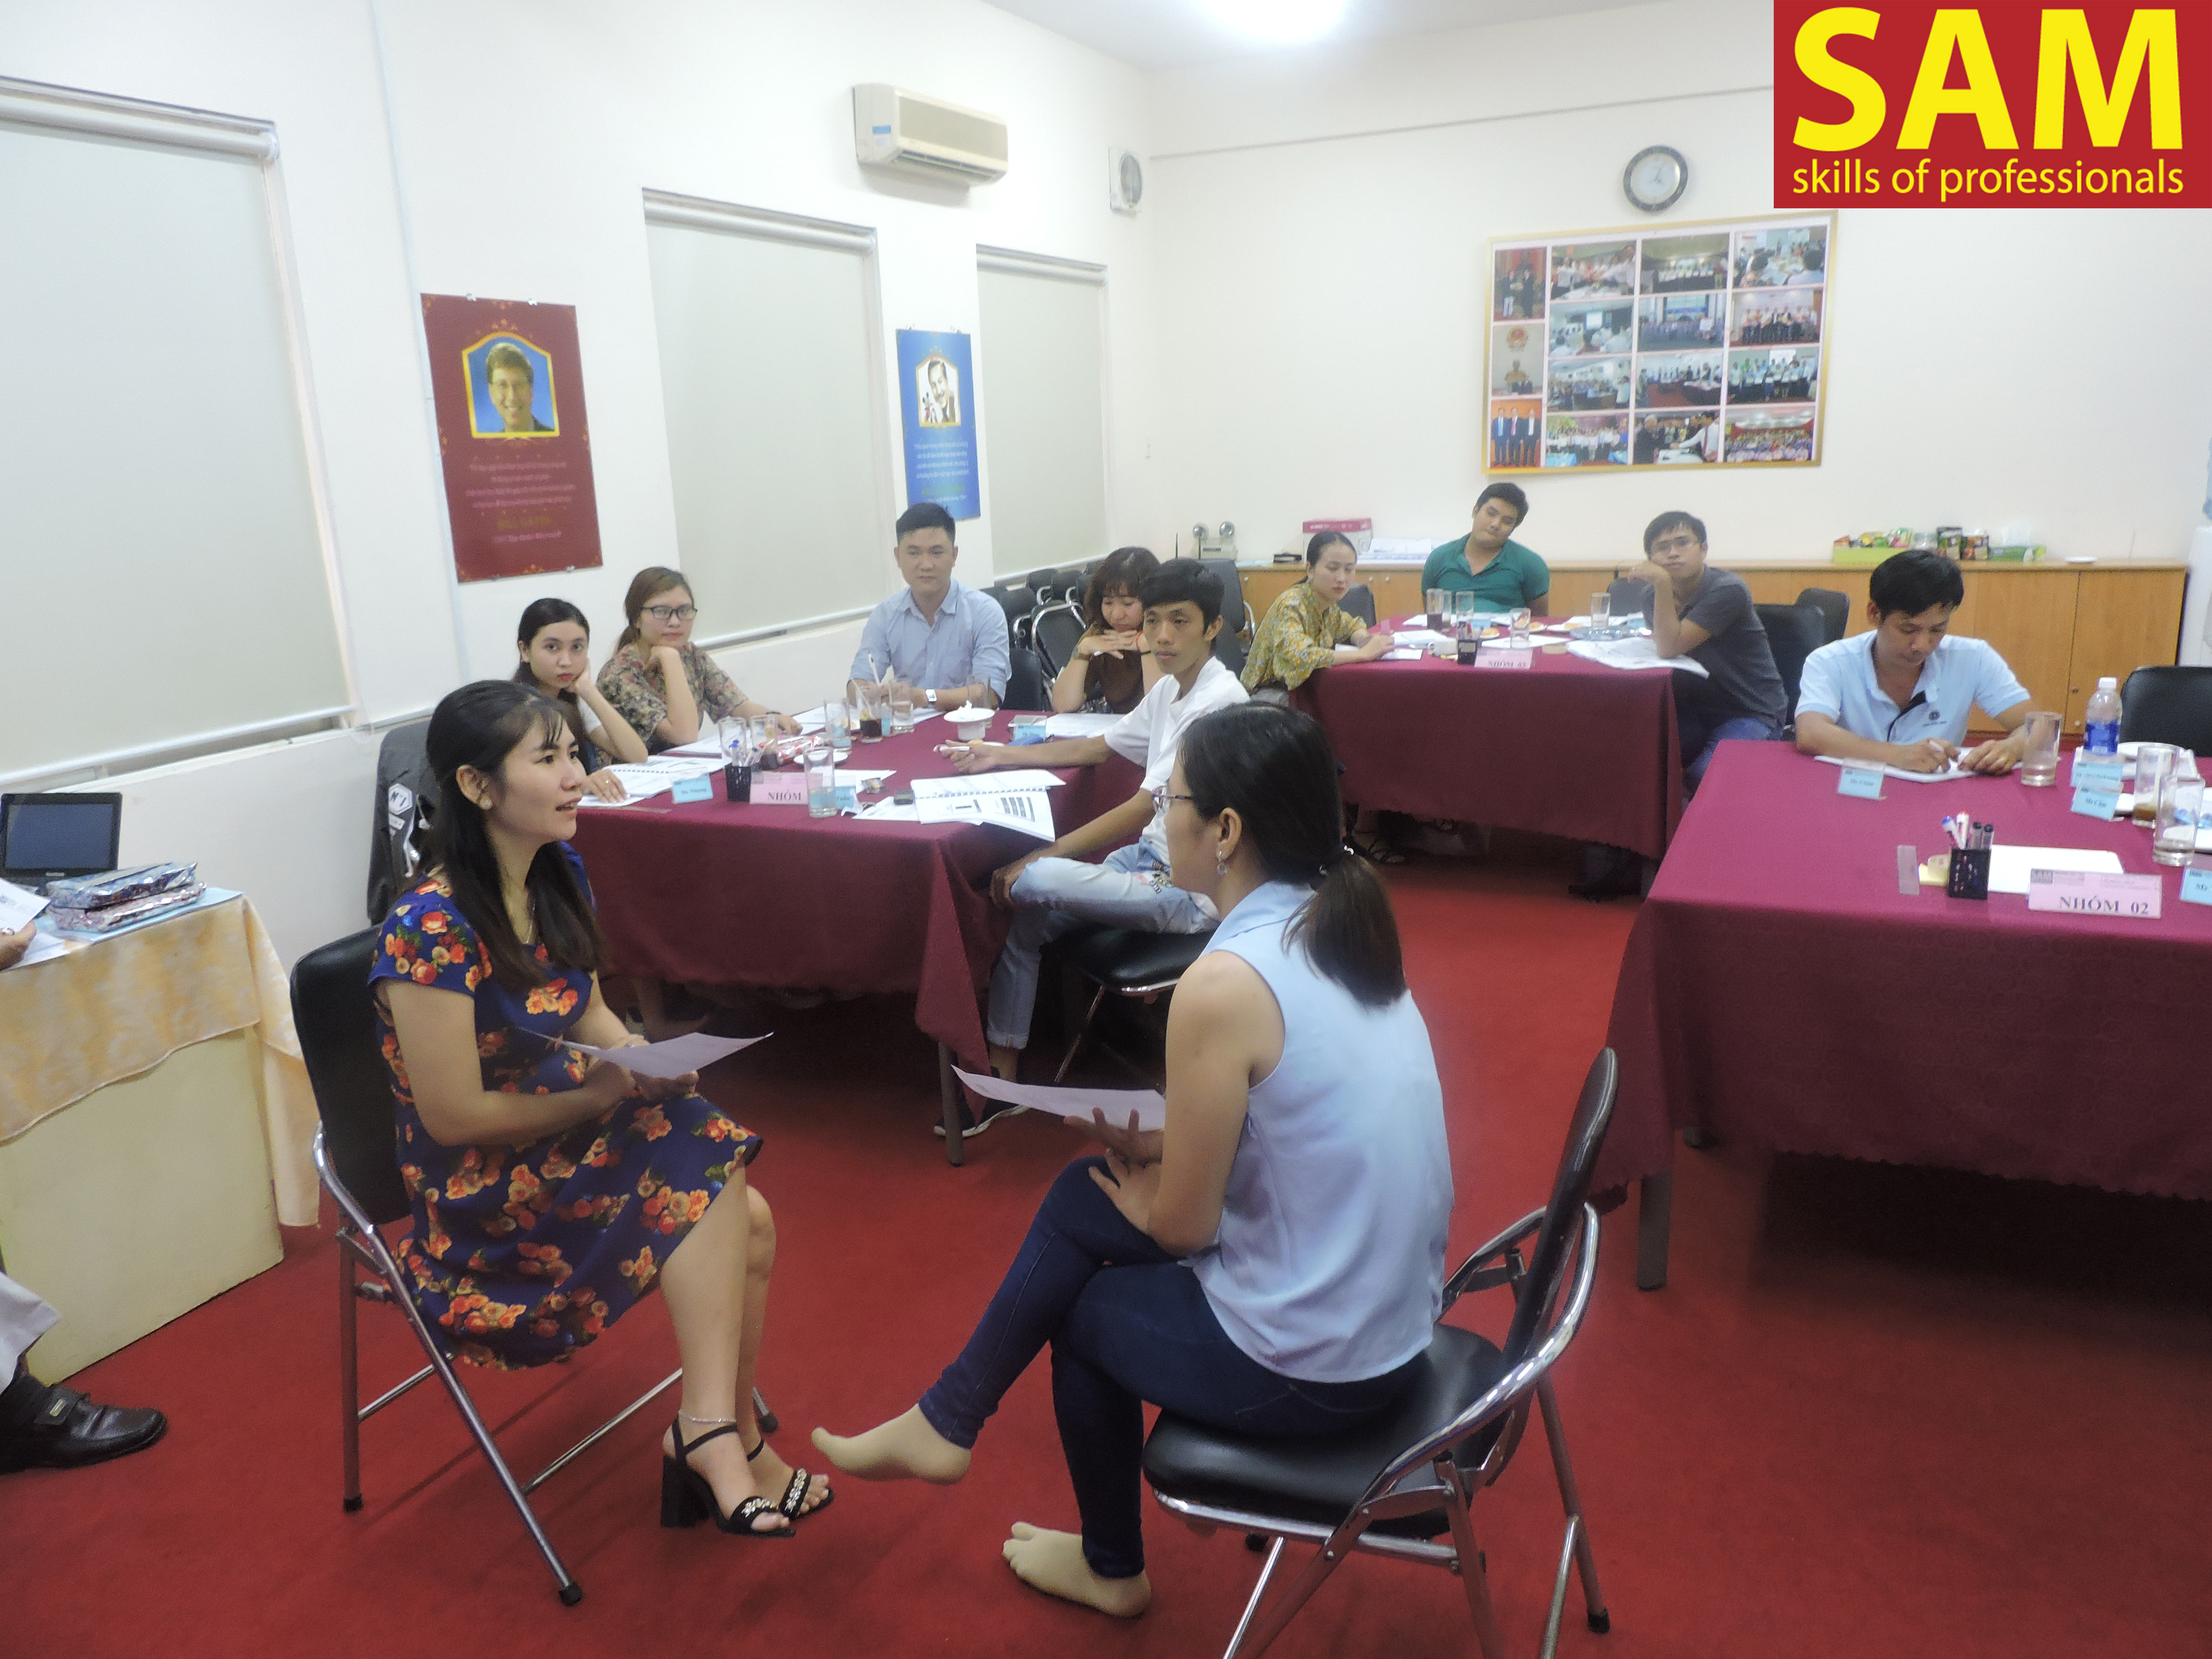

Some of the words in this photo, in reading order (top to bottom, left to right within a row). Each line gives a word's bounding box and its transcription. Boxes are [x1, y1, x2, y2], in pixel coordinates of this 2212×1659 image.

[768, 790, 801, 801] NHÓM
[2059, 895, 2119, 912] NHÓM
[2130, 902, 2149, 915] 02
